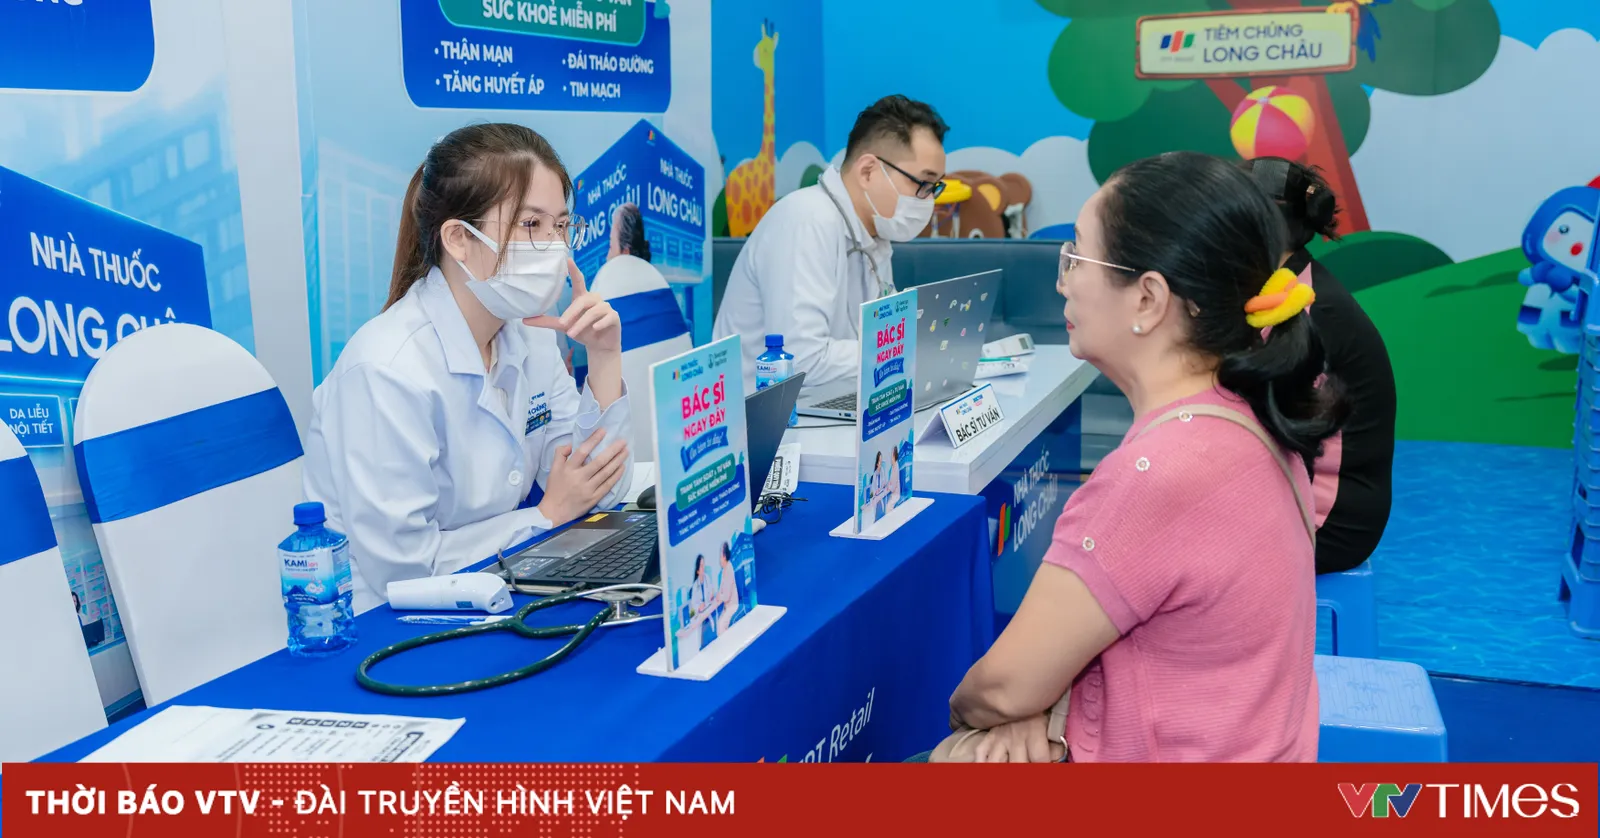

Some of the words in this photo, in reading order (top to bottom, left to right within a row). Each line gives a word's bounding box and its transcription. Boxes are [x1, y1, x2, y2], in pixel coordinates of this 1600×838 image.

[596, 9, 617, 32] PHÍ
[1204, 25, 1240, 41] TIÊM
[441, 38, 480, 65] THẬN
[483, 44, 513, 68] MẠN
[568, 50, 587, 70] ĐÁI
[589, 52, 618, 72] THÁO
[619, 54, 654, 75] ĐƯỜNG
[1204, 46, 1260, 63] LONG
[1266, 39, 1322, 61] CHÂU
[443, 70, 481, 93] TĂNG
[484, 71, 526, 95] HUYẾT
[528, 74, 545, 95] ÁP
[570, 81, 589, 98] TIM
[591, 82, 621, 102] MẠCH
[648, 182, 679, 218] LONG
[30, 232, 86, 277] NHÀ
[88, 248, 162, 292] THUỐC
[877, 324, 896, 349] BÁC
[897, 317, 906, 341] SĨ
[877, 348, 893, 364] NGAY
[681, 385, 711, 420] BÁC
[713, 373, 725, 405] SĨ
[10, 408, 26, 420] DA
[32, 419, 54, 434] TIẾT
[683, 417, 707, 441] NGAY
[709, 407, 726, 428] ĐÂY
[956, 423, 972, 442] BÁC
[970, 417, 979, 434] SĨ
[985, 405, 1001, 425] VẤN
[1014, 468, 1029, 508] NHÀ
[1014, 500, 1037, 553] LONG
[284, 559, 308, 568] KAMI
[829, 687, 875, 763] Retail
